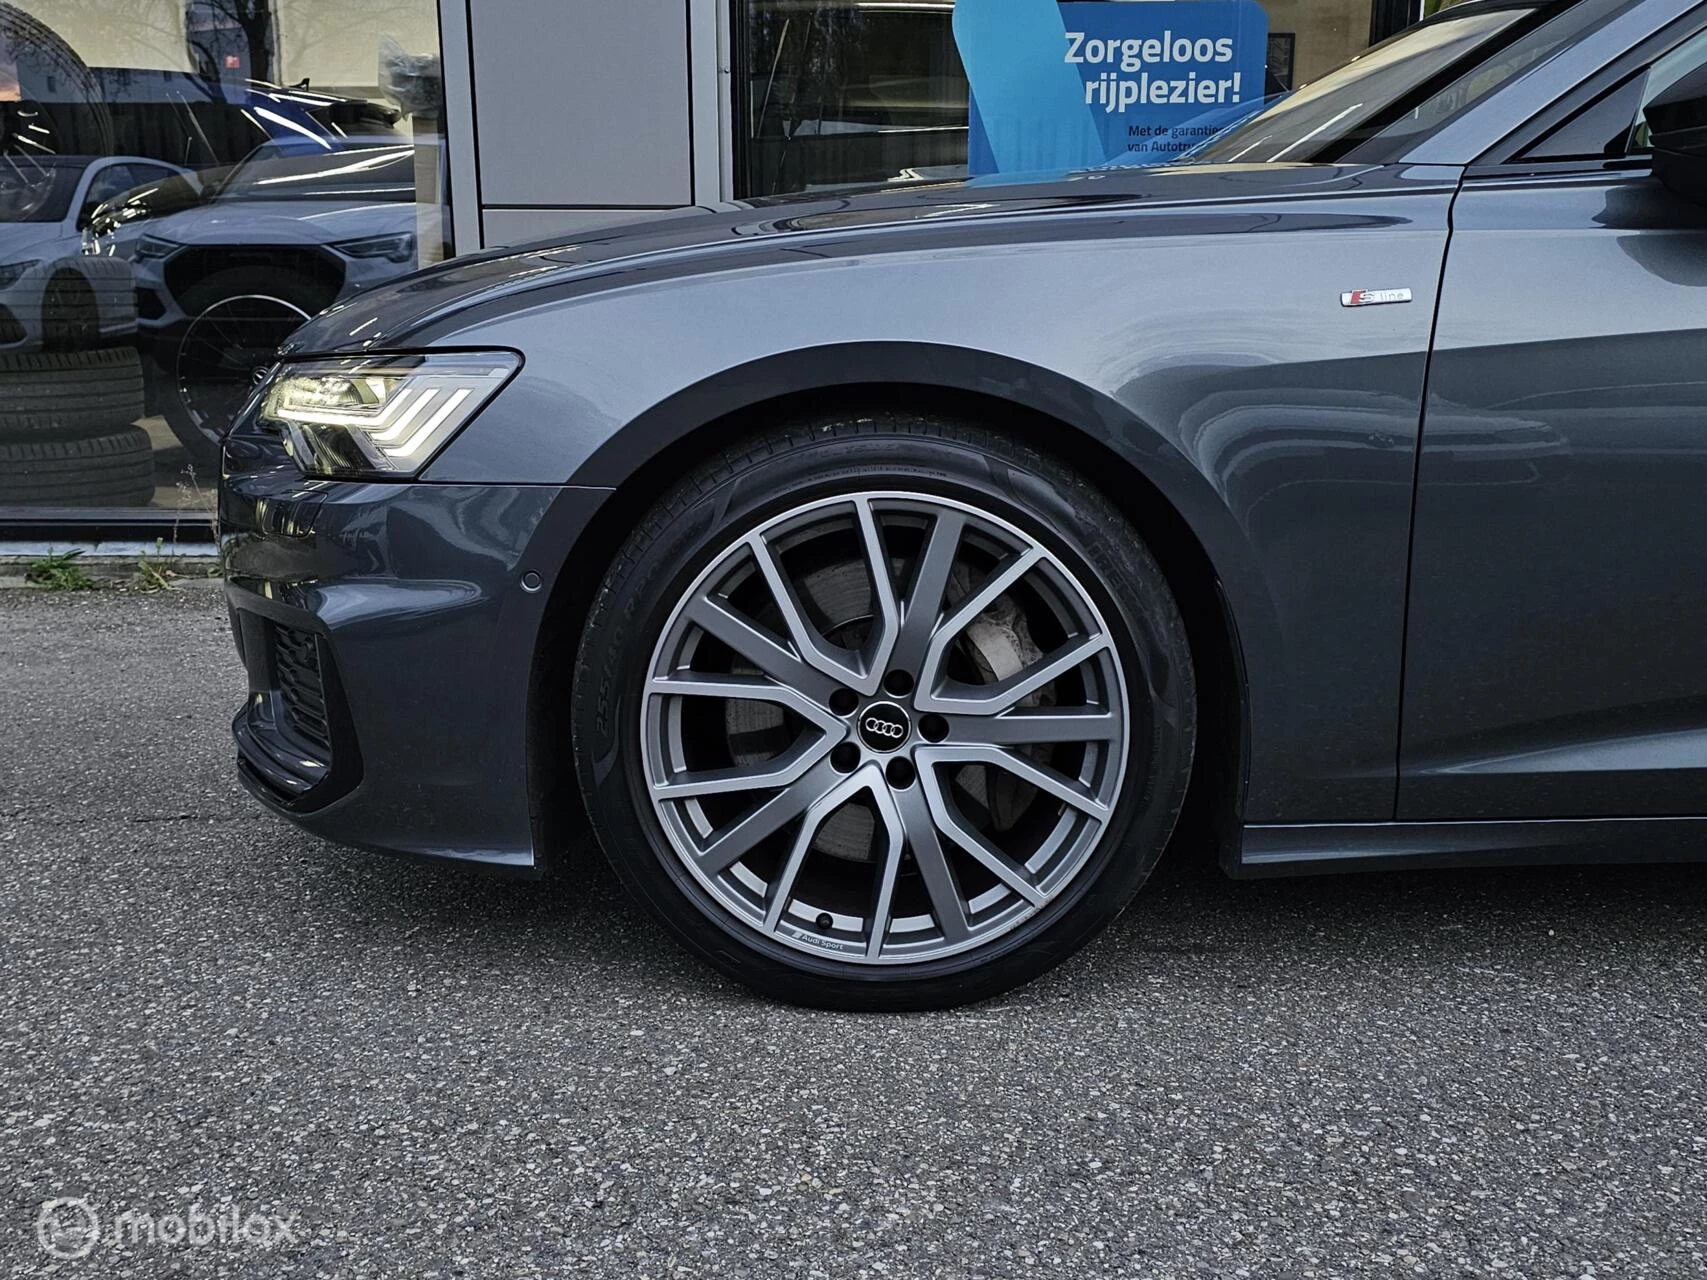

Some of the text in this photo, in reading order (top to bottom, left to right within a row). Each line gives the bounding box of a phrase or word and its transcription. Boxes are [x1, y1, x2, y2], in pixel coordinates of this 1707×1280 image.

[1064, 30, 1233, 72] Zorgeloos
[1085, 72, 1241, 113] rijplezier!
[1128, 125, 1151, 136] Met
[1154, 125, 1168, 136] de
[1127, 142, 1148, 152] van
[802, 934, 844, 950] Audi Sport
